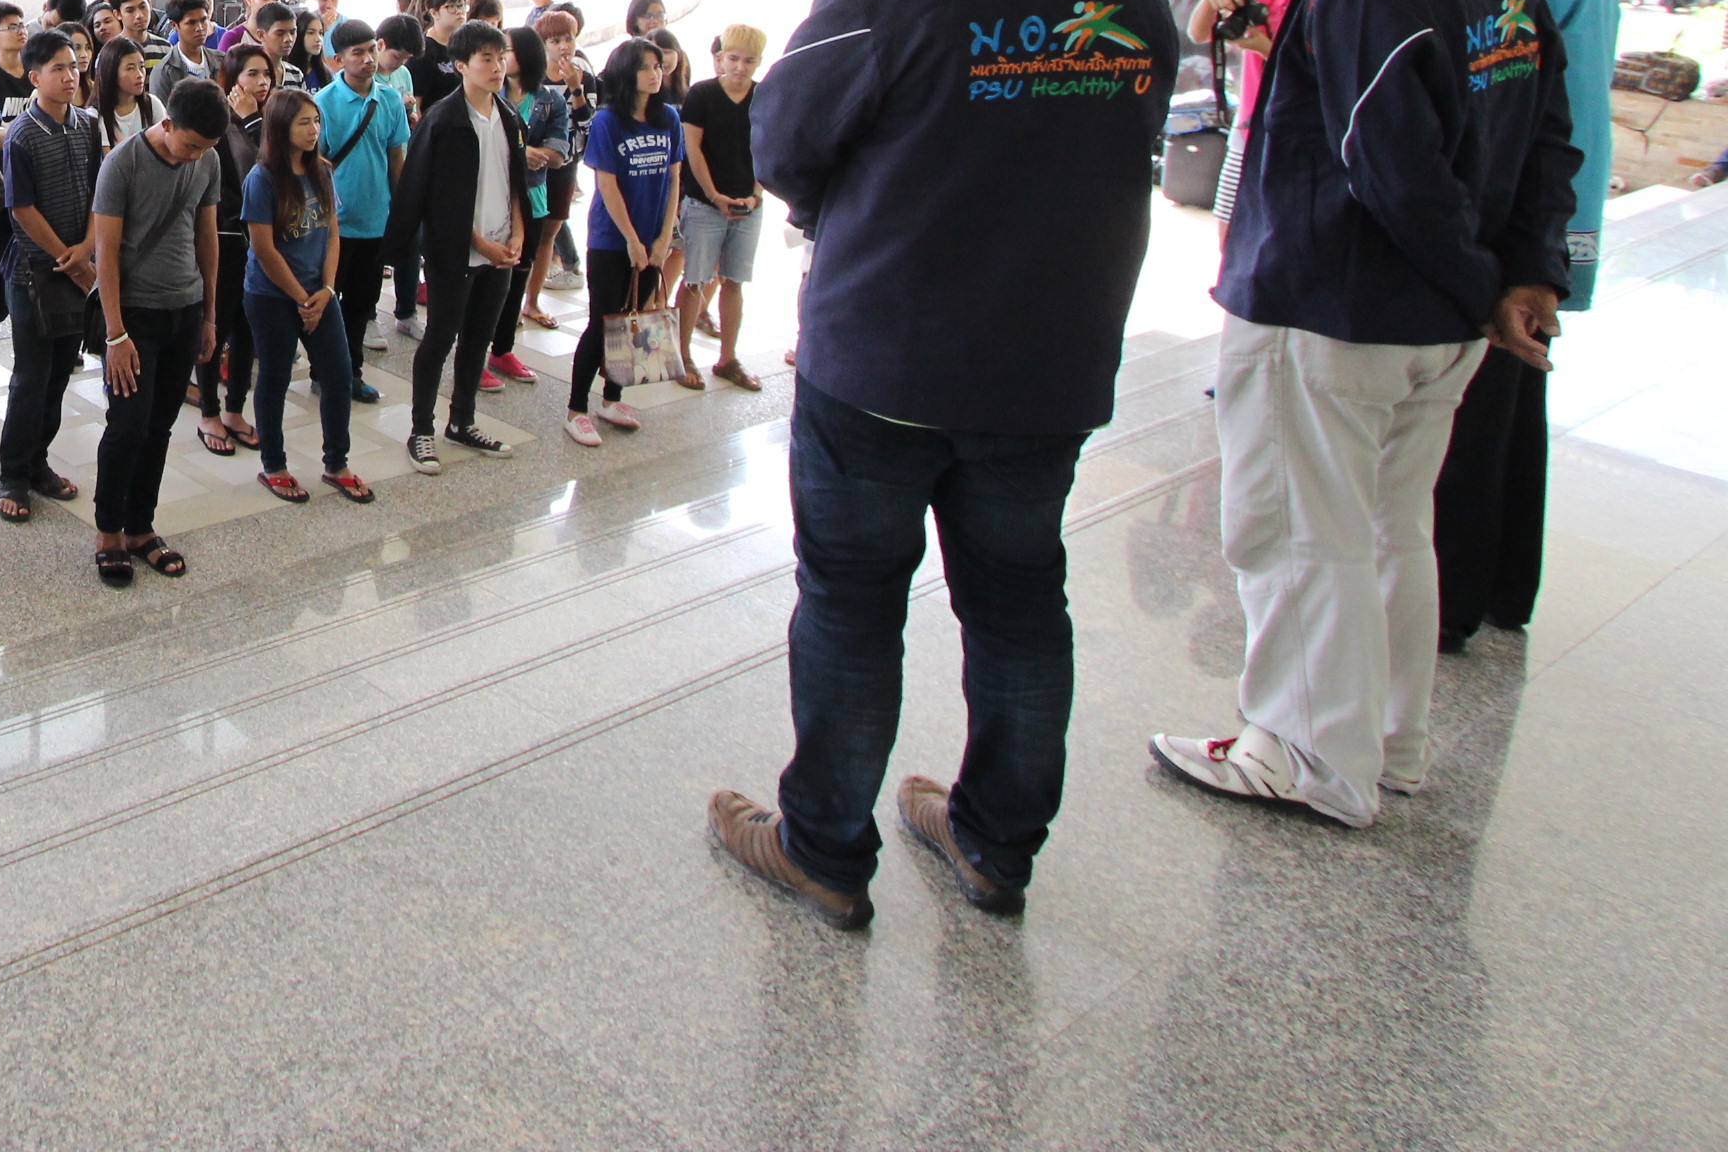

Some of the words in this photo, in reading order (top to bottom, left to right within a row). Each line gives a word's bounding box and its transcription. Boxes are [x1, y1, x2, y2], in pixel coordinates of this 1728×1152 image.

[969, 79, 1024, 100] PSU
[1031, 75, 1124, 100] Healthy
[1134, 74, 1153, 95] U
[2, 96, 31, 117] NIK
